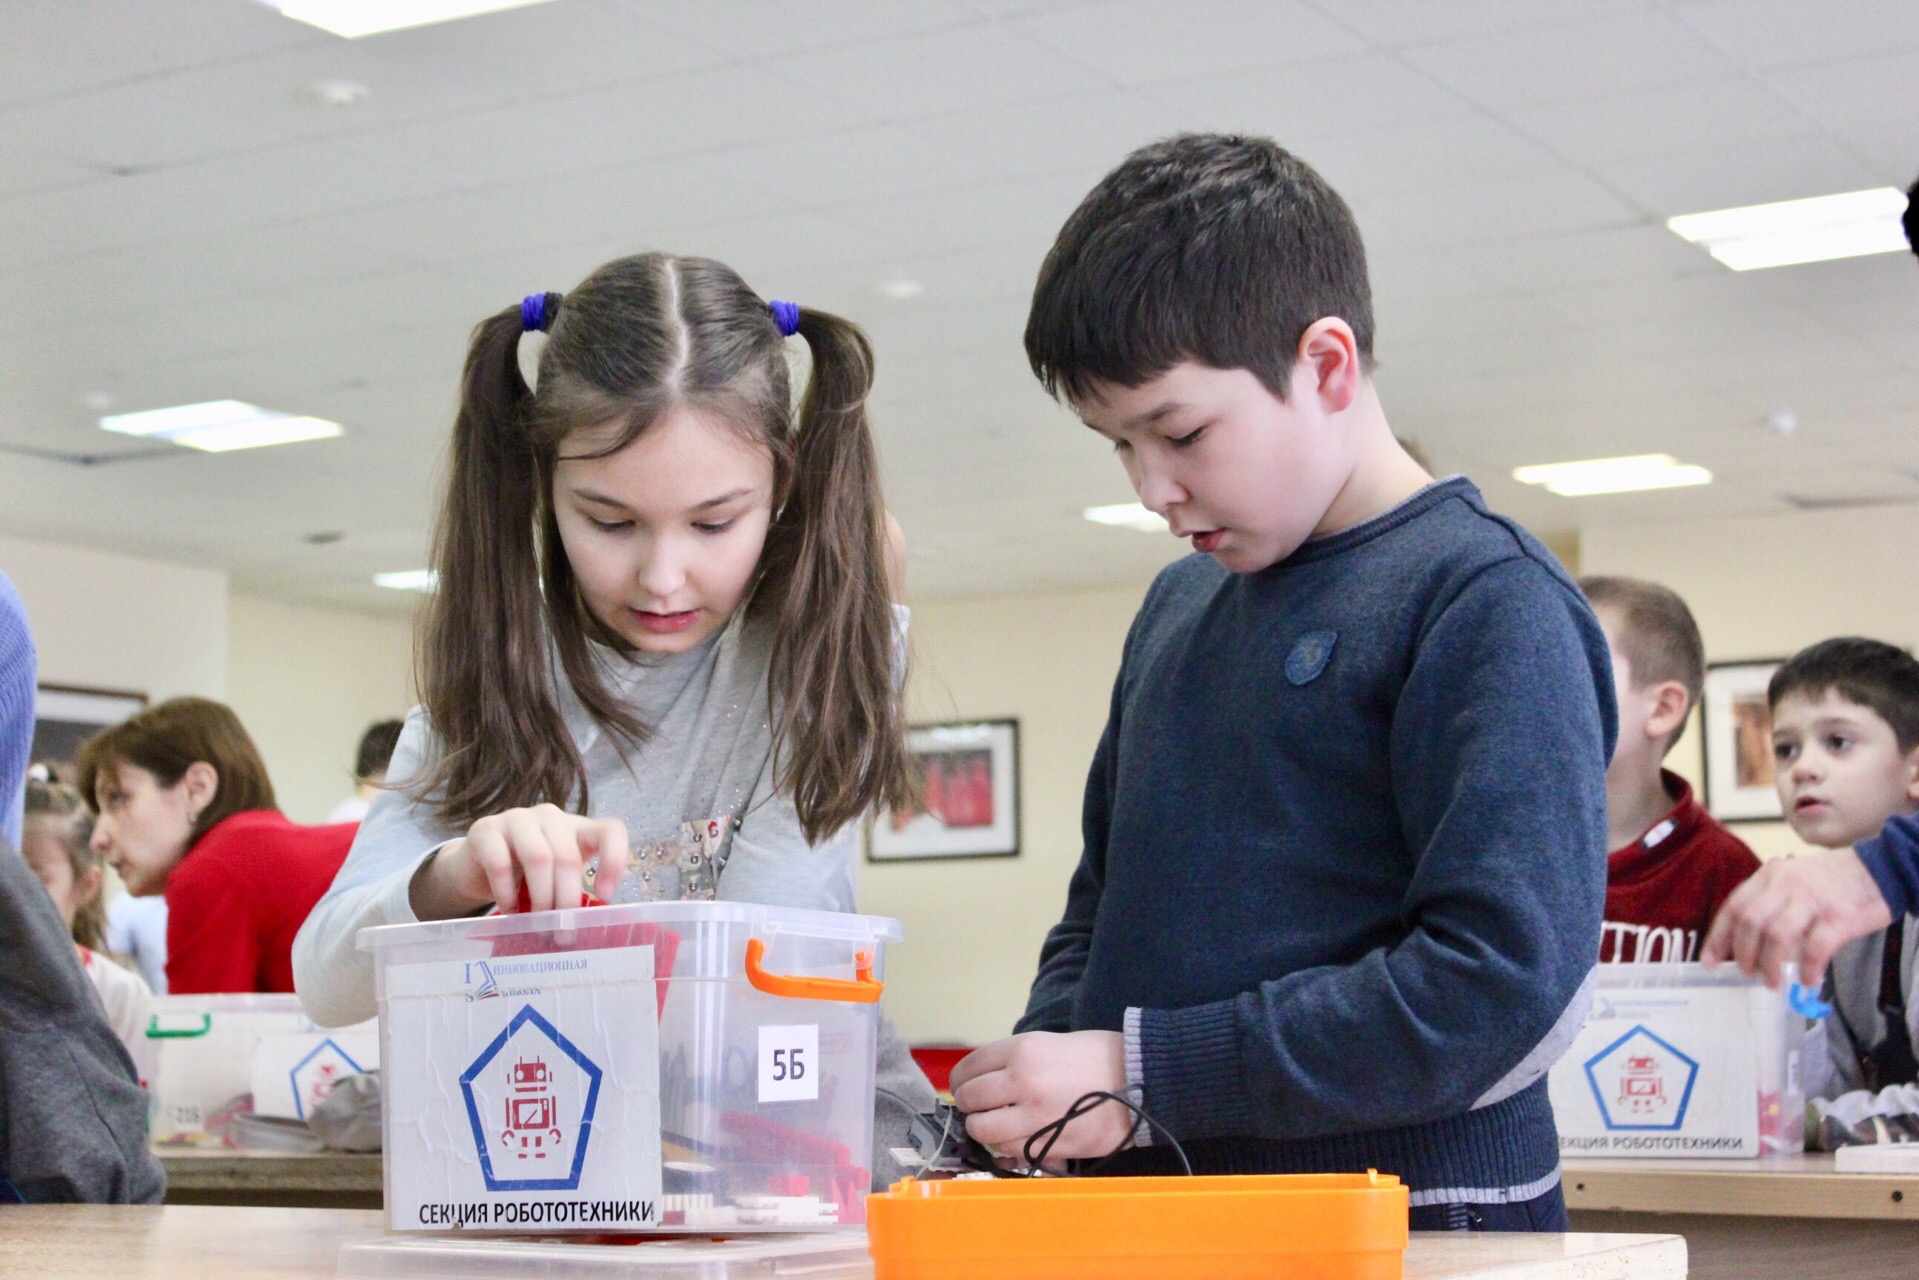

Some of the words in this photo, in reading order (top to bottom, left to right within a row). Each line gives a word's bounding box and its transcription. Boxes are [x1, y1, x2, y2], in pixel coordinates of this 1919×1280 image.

[492, 958, 588, 976] ИННОВАЦИОННАЯ
[772, 1048, 805, 1081] 5Б
[1557, 1136, 1609, 1151] ЕКЦИЯ
[1612, 1136, 1743, 1151] РОБОТОТЕХНИКИ
[418, 1202, 488, 1227] СЕКЦИЯ
[494, 1200, 654, 1223] РОБОТОТЕХНИКИ
